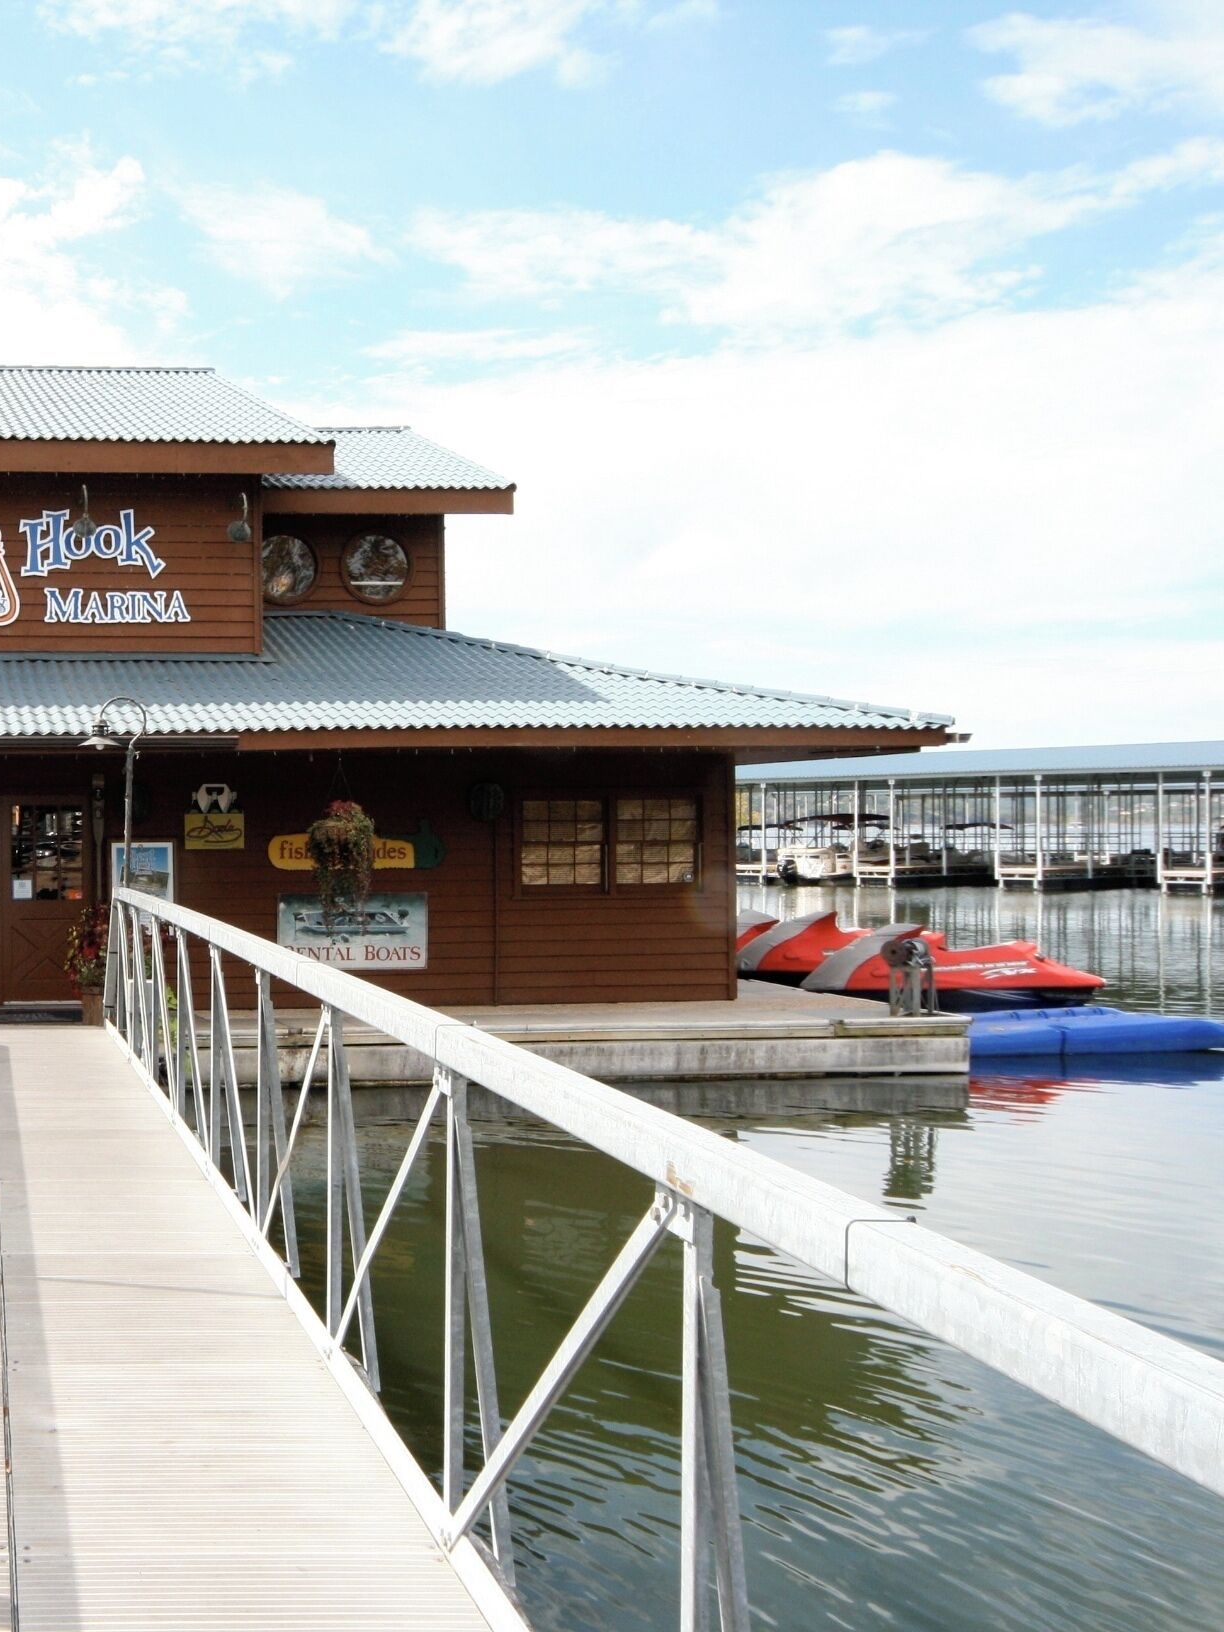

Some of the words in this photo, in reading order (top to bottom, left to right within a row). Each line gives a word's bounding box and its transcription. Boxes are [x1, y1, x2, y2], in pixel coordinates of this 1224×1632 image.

[19, 508, 166, 579] Hook
[44, 588, 191, 623] MARINA
[364, 944, 421, 961] BOATS
